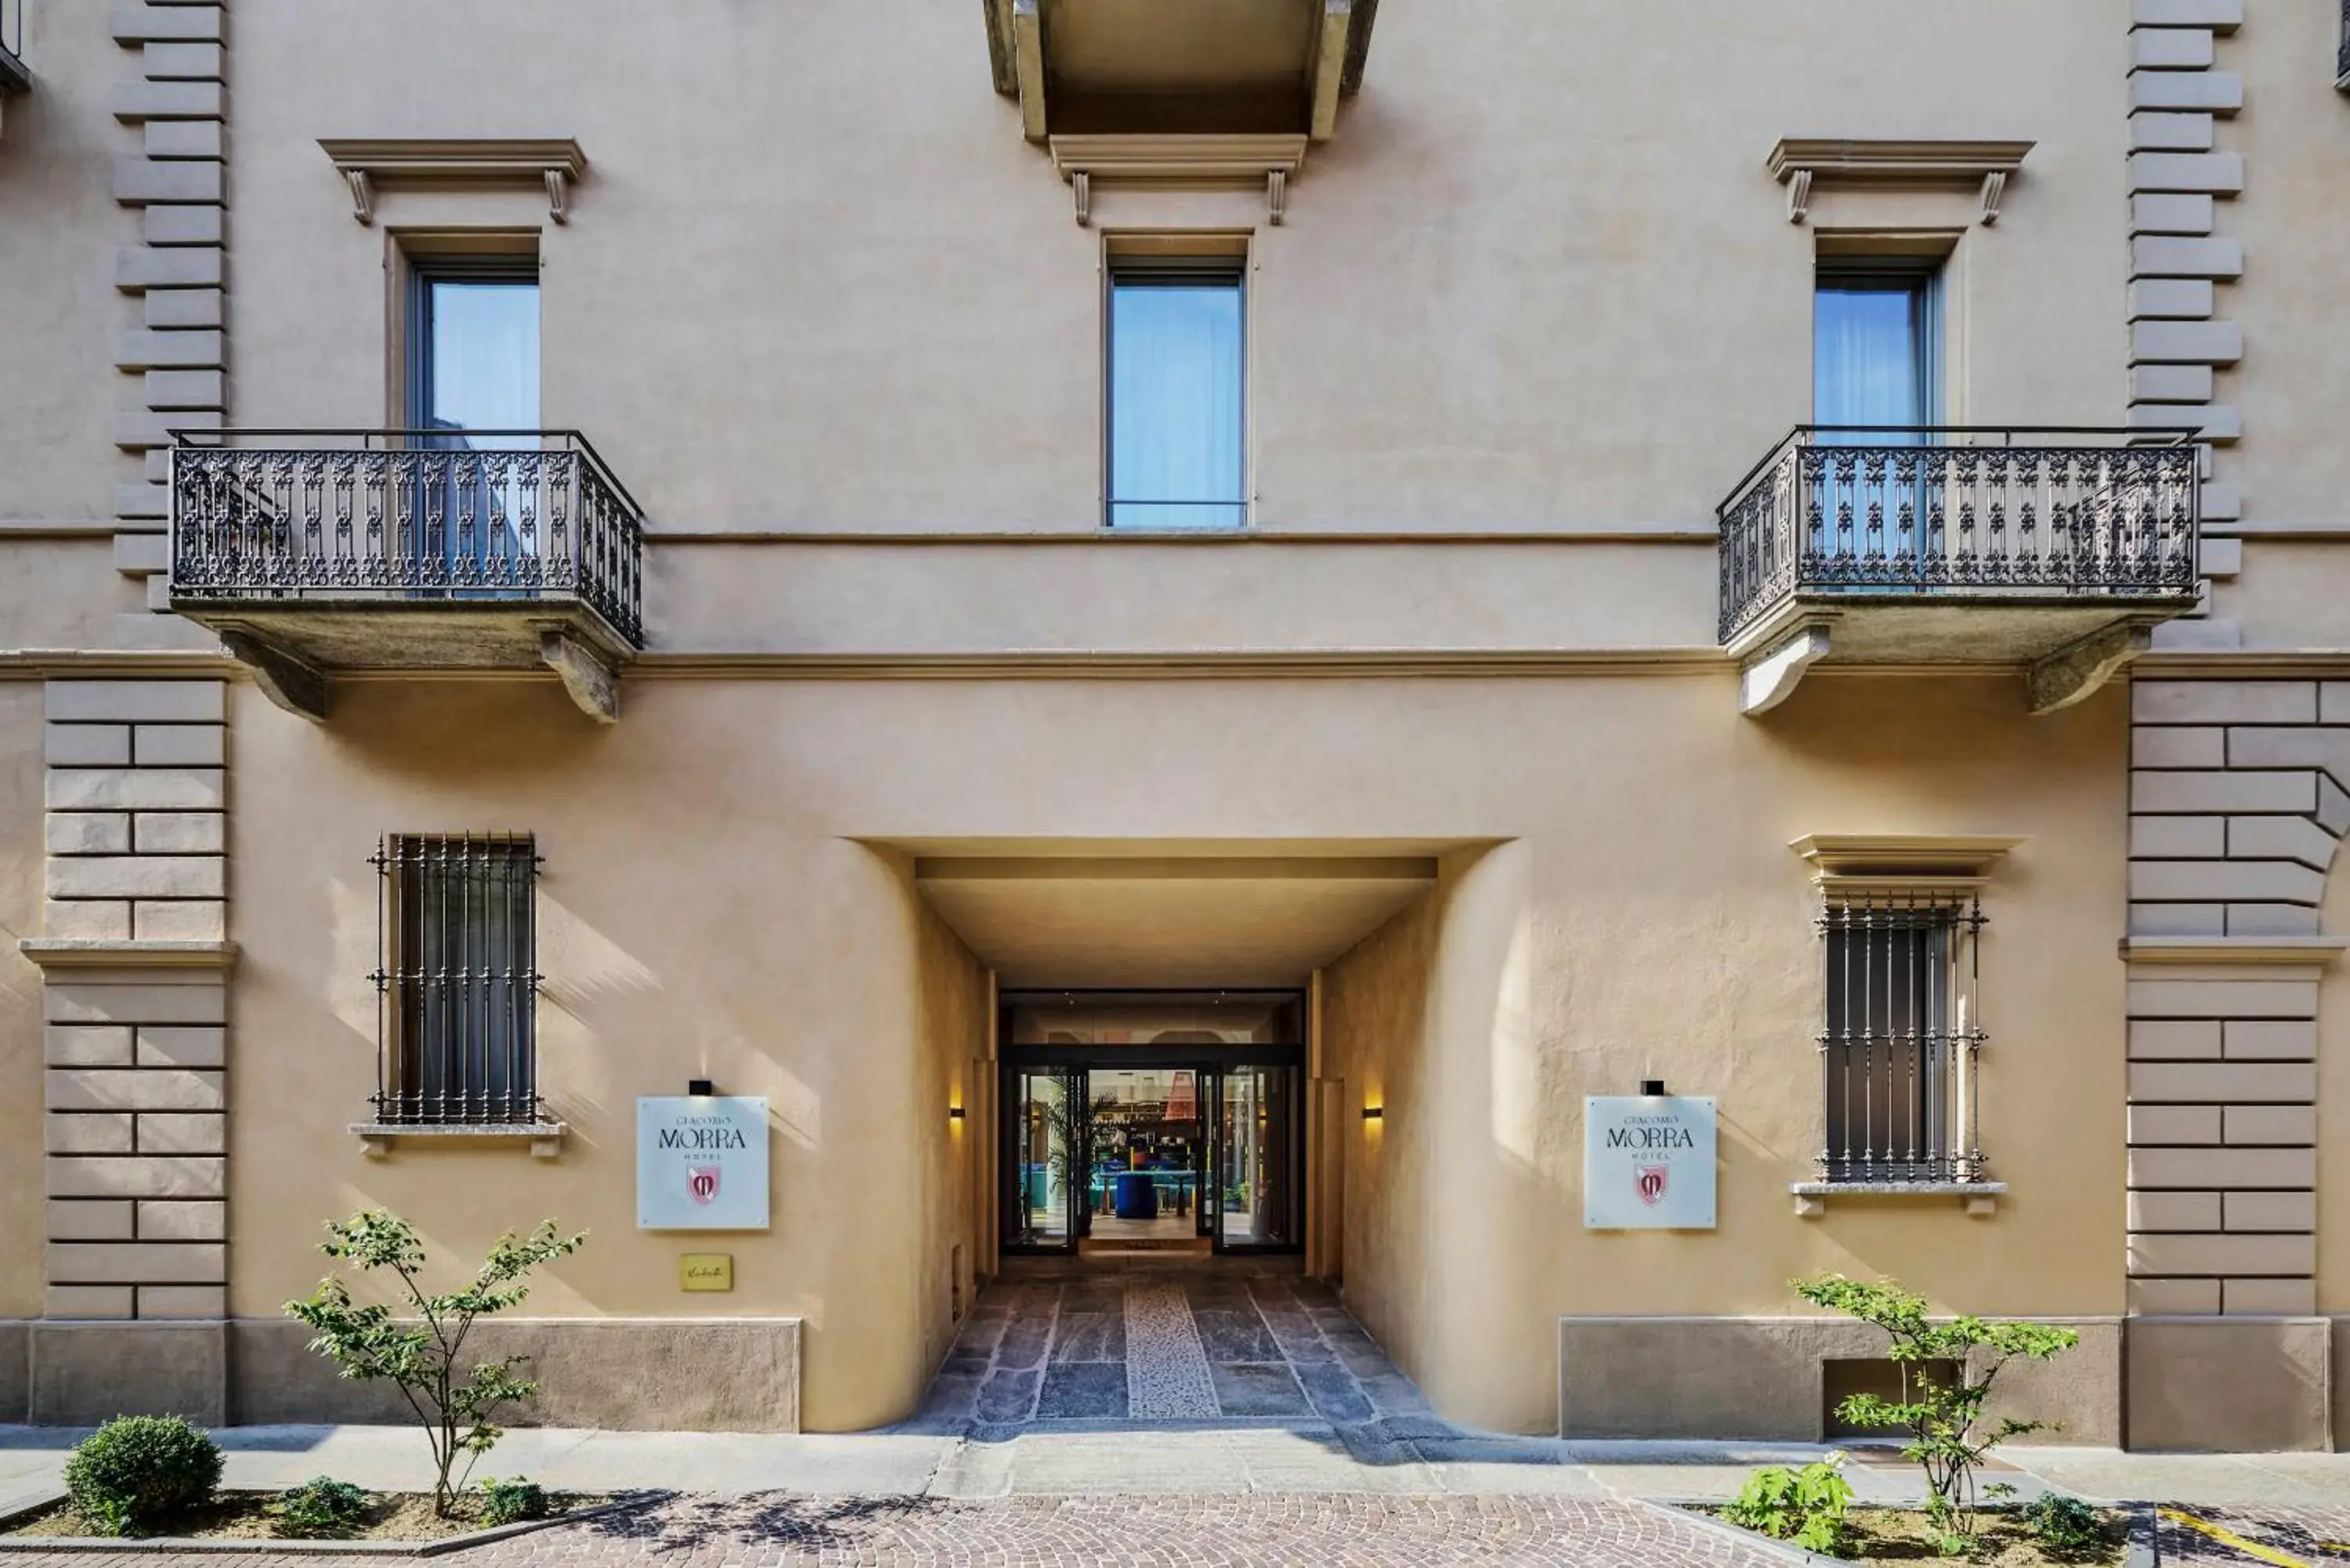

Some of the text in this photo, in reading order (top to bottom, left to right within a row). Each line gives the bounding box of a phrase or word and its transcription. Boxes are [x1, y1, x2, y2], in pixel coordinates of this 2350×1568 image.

[676, 1116, 732, 1125] GIACOMO
[1624, 1115, 1679, 1124] GIACOMO
[659, 1129, 746, 1149] MORRA
[1607, 1128, 1694, 1148] MORRA
